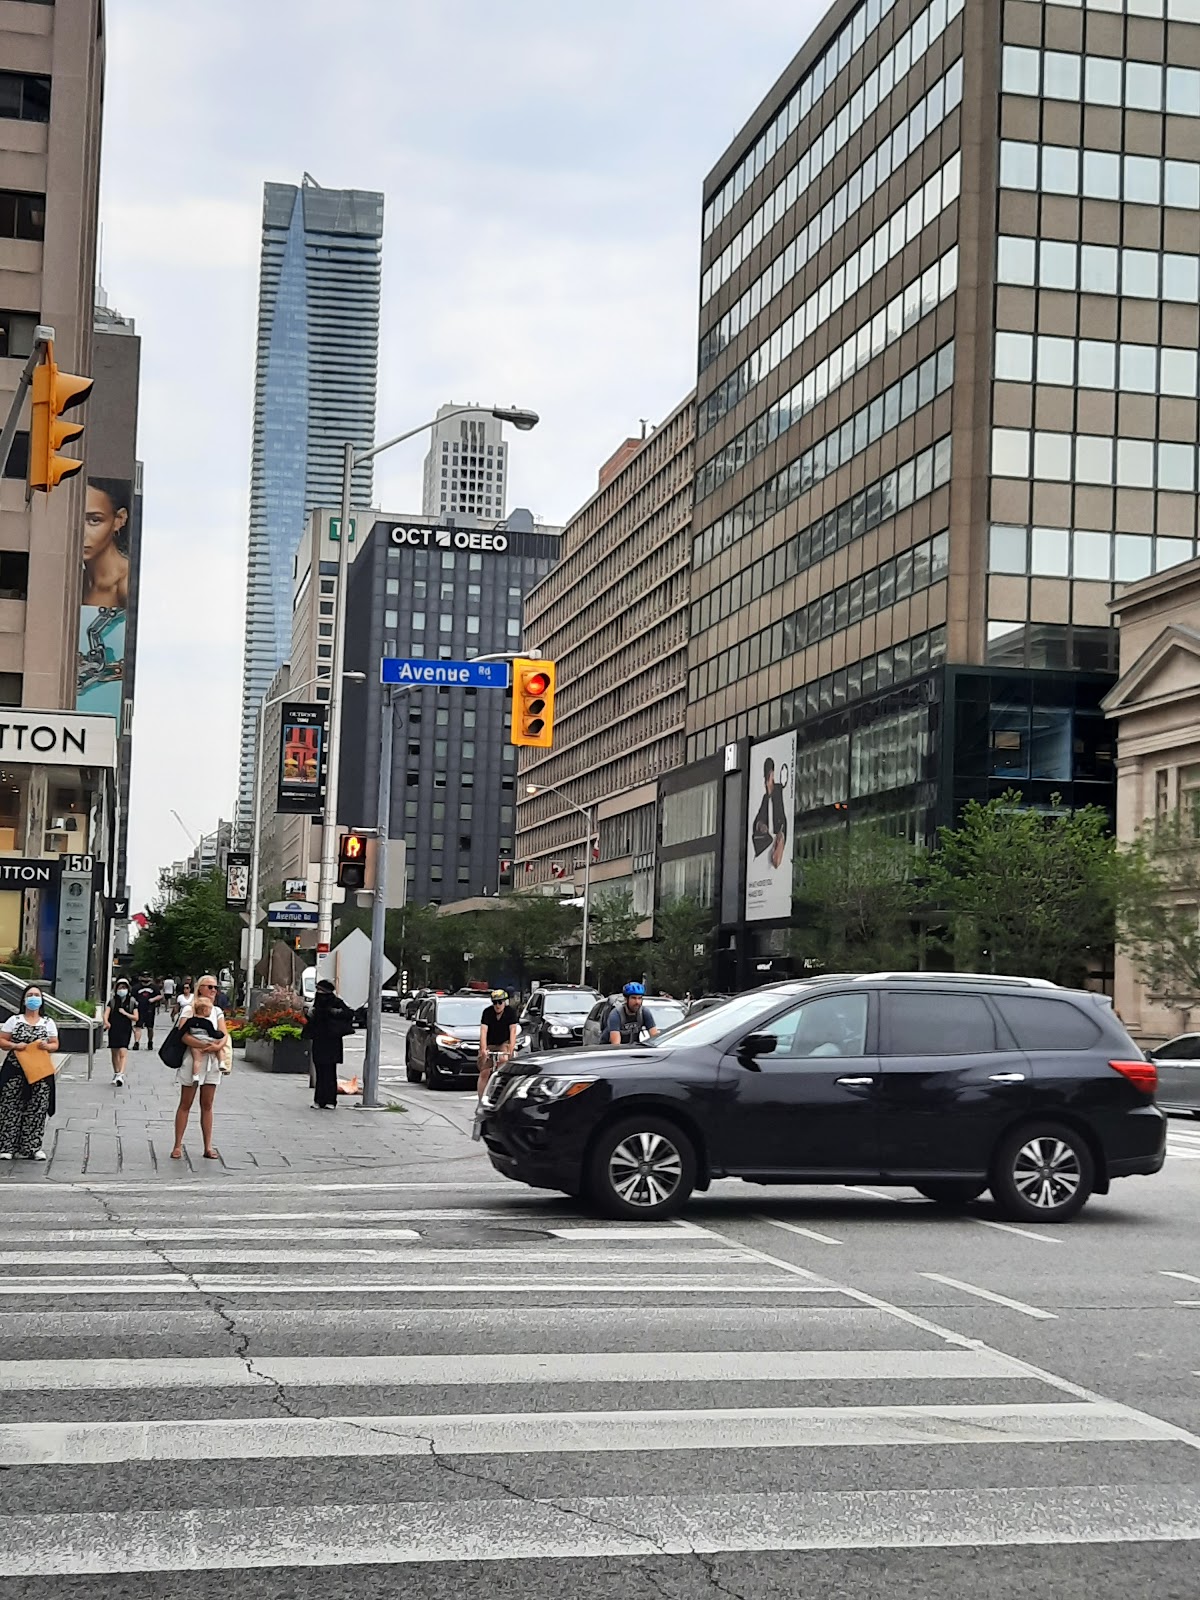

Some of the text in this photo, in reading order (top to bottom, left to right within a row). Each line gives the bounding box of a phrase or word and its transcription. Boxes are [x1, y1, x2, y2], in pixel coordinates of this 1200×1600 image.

[392, 527, 508, 551] OCT OEEO
[399, 662, 470, 682] Avenue
[63, 855, 92, 872] 150
[275, 912, 302, 920] Avenue
